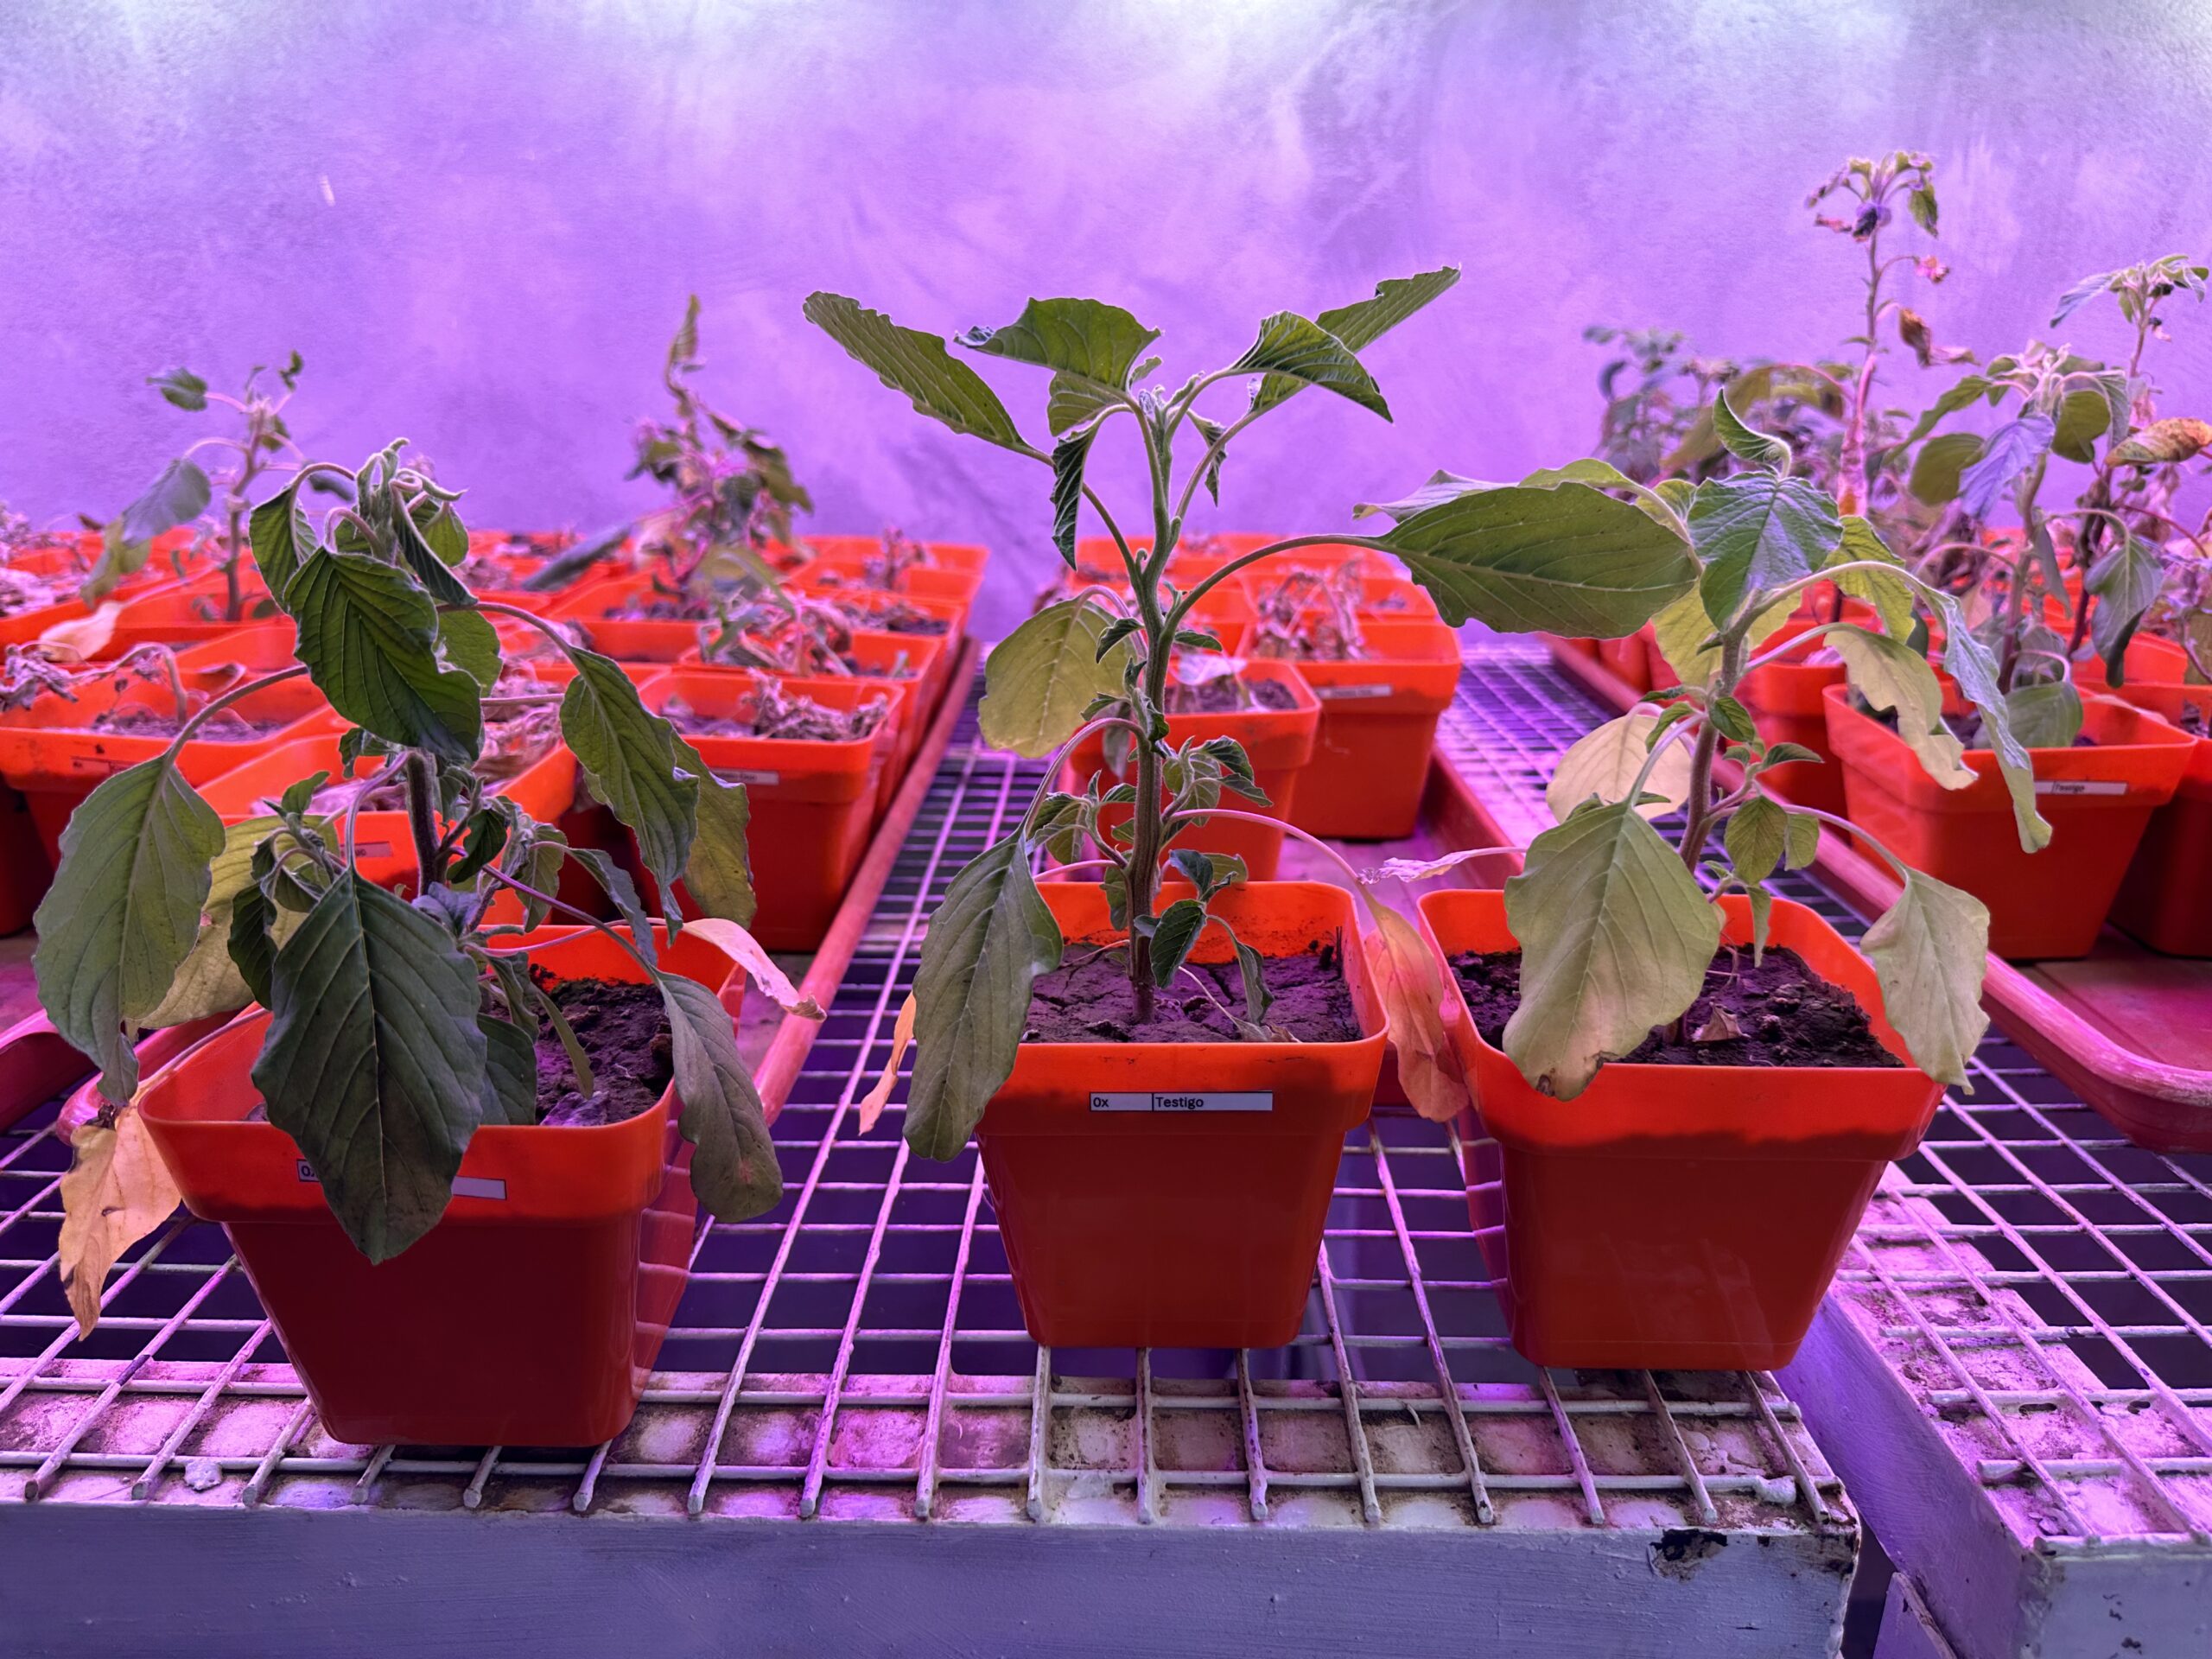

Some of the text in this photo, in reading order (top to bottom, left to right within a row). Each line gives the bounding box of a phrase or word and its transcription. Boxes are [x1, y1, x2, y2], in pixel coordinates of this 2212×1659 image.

[1093, 1096, 1204, 1109] 0x Testigo
[301, 1165, 315, 1177] 0
